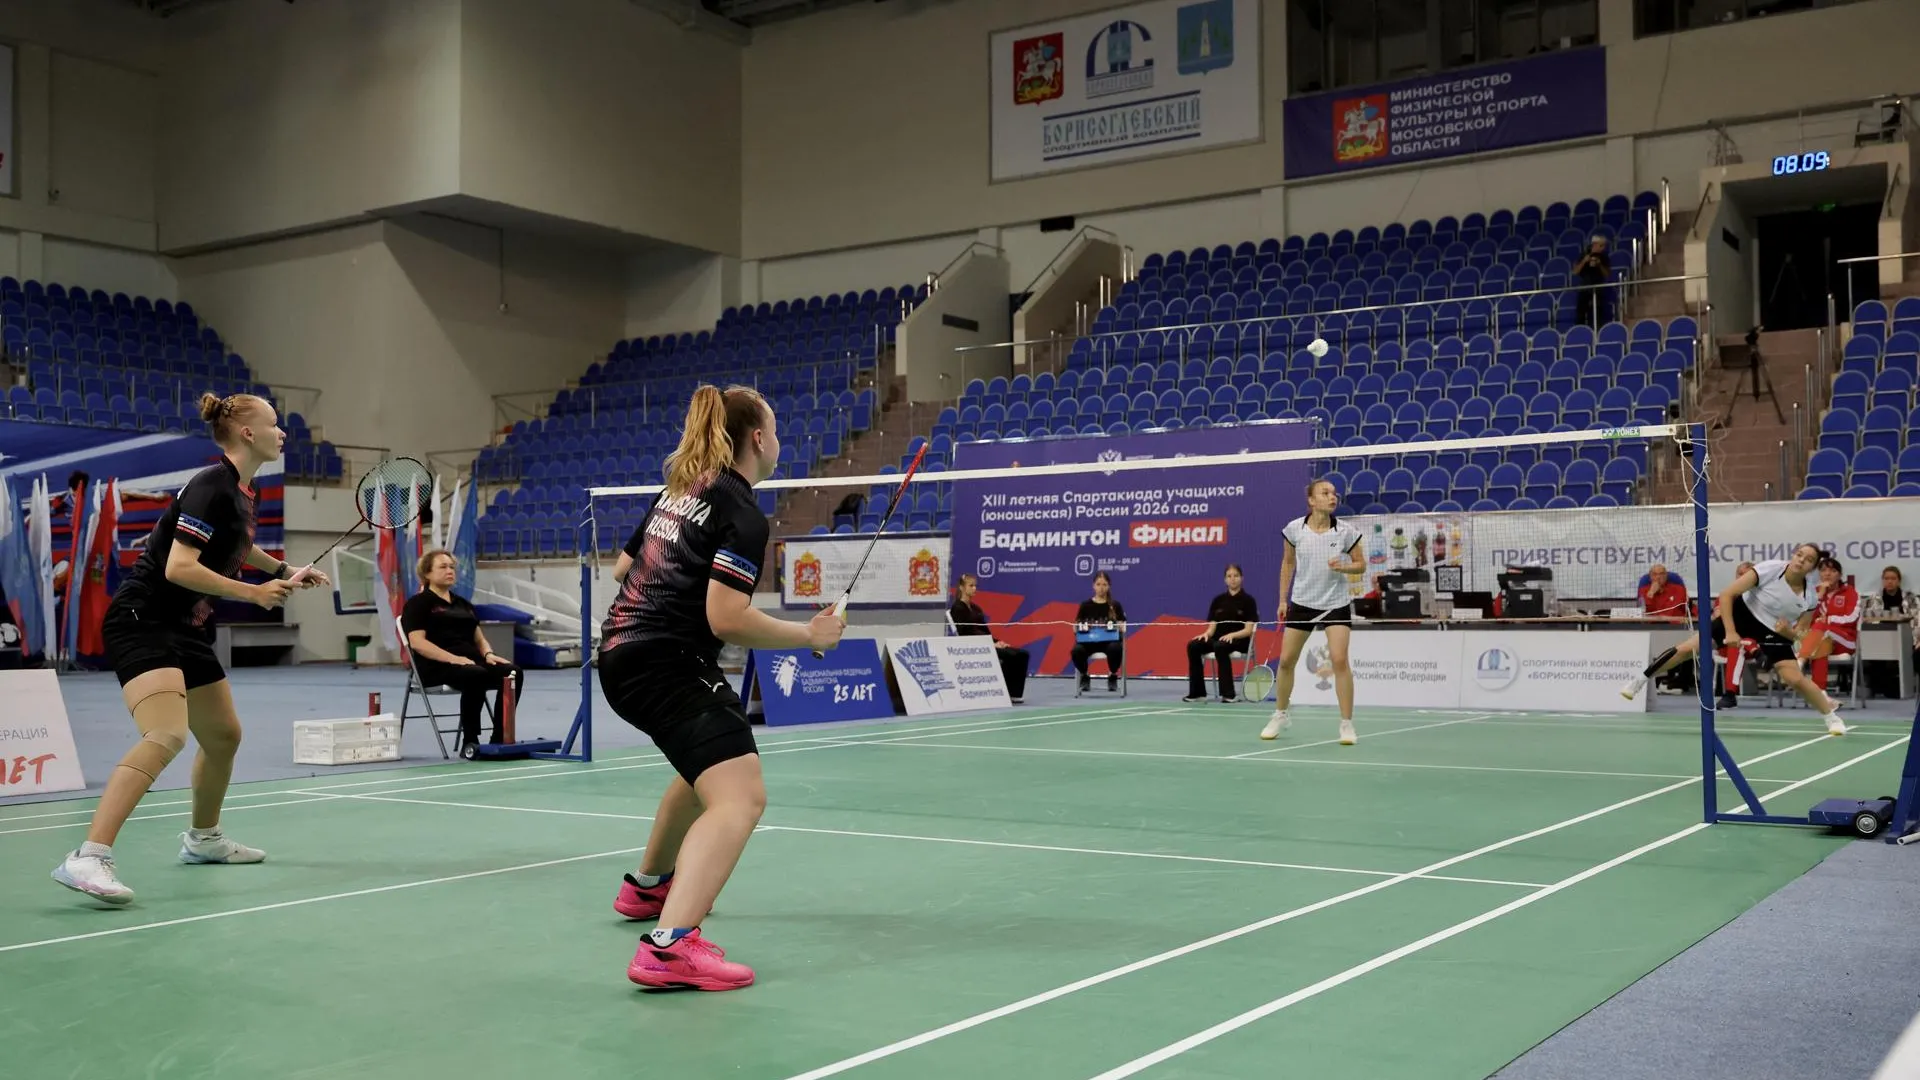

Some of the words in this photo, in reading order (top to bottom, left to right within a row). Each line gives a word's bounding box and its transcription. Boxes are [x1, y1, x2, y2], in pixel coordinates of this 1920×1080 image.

[1391, 74, 1512, 101] МИНИСТЕРСТВО
[1391, 88, 1494, 114] ФИЗИЧЕСКОЙ
[1391, 107, 1467, 129] КУЛЬТУРЫ
[1472, 105, 1482, 116] И
[1486, 95, 1549, 114] СПОРТА
[1391, 116, 1496, 142] МОСКОВСКОЙ
[1391, 136, 1461, 156] ОБЛАСТИ
[1616, 426, 1640, 437] YONEX
[1009, 495, 1059, 506] летняя
[1062, 489, 1162, 505] Спартакиада
[1166, 485, 1245, 502] учащихся
[981, 506, 1072, 524] (юношеская)
[1075, 504, 1129, 518] России
[1132, 502, 1169, 516] 2026
[1173, 502, 1209, 516] года
[646, 514, 680, 543] RUSSIA
[979, 529, 1121, 552] Бадминтон
[1132, 523, 1224, 545] Финал
[1491, 546, 1666, 566] ПРИВЕТСТВУЕМ
[1673, 542, 1837, 564] УАСТНИКВ
[947, 646, 991, 656] Московская
[1352, 659, 1409, 670] Министерство
[1410, 661, 1438, 671] спорта
[1522, 659, 1587, 668] СПОРТИВНЫЙ
[1590, 660, 1643, 669] КОМПЛЕКС
[1399, 672, 1447, 684] Федерации
[1527, 670, 1636, 681] «БОРИСОГЛЕБСКИЙ»
[833, 683, 850, 704] 25
[851, 683, 877, 702] ЛЕТ
[959, 688, 1004, 700] бадминтона
